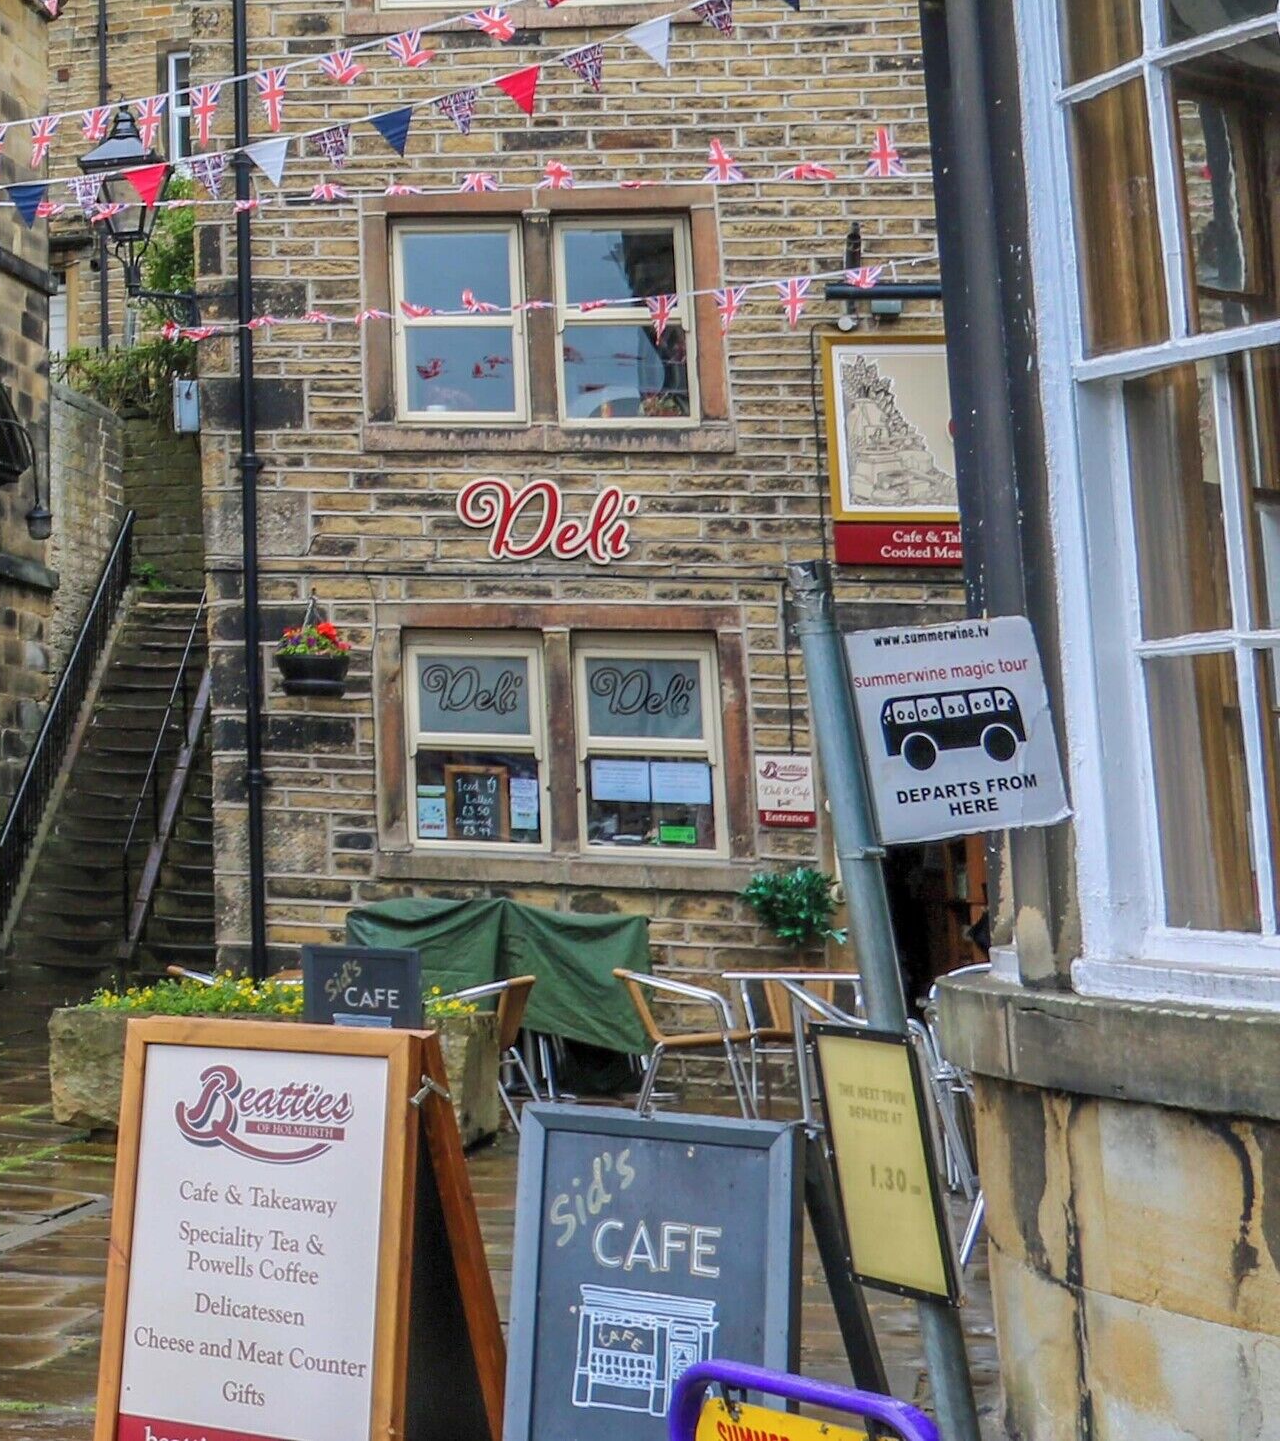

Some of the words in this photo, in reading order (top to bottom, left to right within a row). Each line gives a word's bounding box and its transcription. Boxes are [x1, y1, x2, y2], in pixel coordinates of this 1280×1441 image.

[456, 476, 640, 564] Deli
[880, 545, 931, 558] Cooked
[892, 530, 922, 543] Cafe
[925, 531, 940, 543] &
[874, 625, 989, 647] www.summerwine.tv
[854, 666, 947, 688] summerwine
[951, 661, 995, 683] magic
[998, 657, 1029, 673] tour
[421, 663, 523, 715] Deli
[590, 667, 696, 719] Deli
[896, 780, 981, 804] DEPARTS
[987, 773, 1037, 793] FROM
[765, 811, 810, 823] Entrance
[949, 798, 999, 817] HERE
[324, 959, 362, 1002] Sid's
[344, 986, 400, 1009] CAFE
[175, 1064, 355, 1164] Beatties
[256, 1122, 271, 1133] OF
[272, 1124, 334, 1139] HOLMFIRTH
[870, 1163, 907, 1193] 1.30
[179, 1180, 218, 1204] Cafe
[225, 1184, 243, 1206] &
[248, 1186, 337, 1218] Takeaway
[550, 1149, 636, 1247] Sid's
[178, 1220, 264, 1252] Speciality
[269, 1230, 299, 1253] Tea
[306, 1234, 325, 1256] &
[592, 1218, 722, 1278] CAFE
[186, 1250, 254, 1278] Powells
[259, 1258, 319, 1286] Coffee
[194, 1292, 305, 1326] Delicatessen
[133, 1326, 195, 1353] Cheese
[199, 1339, 233, 1359] and
[237, 1340, 284, 1366] Meat
[289, 1347, 367, 1379] Counter
[598, 1323, 644, 1352] CAFE
[222, 1380, 266, 1407] Gifts
